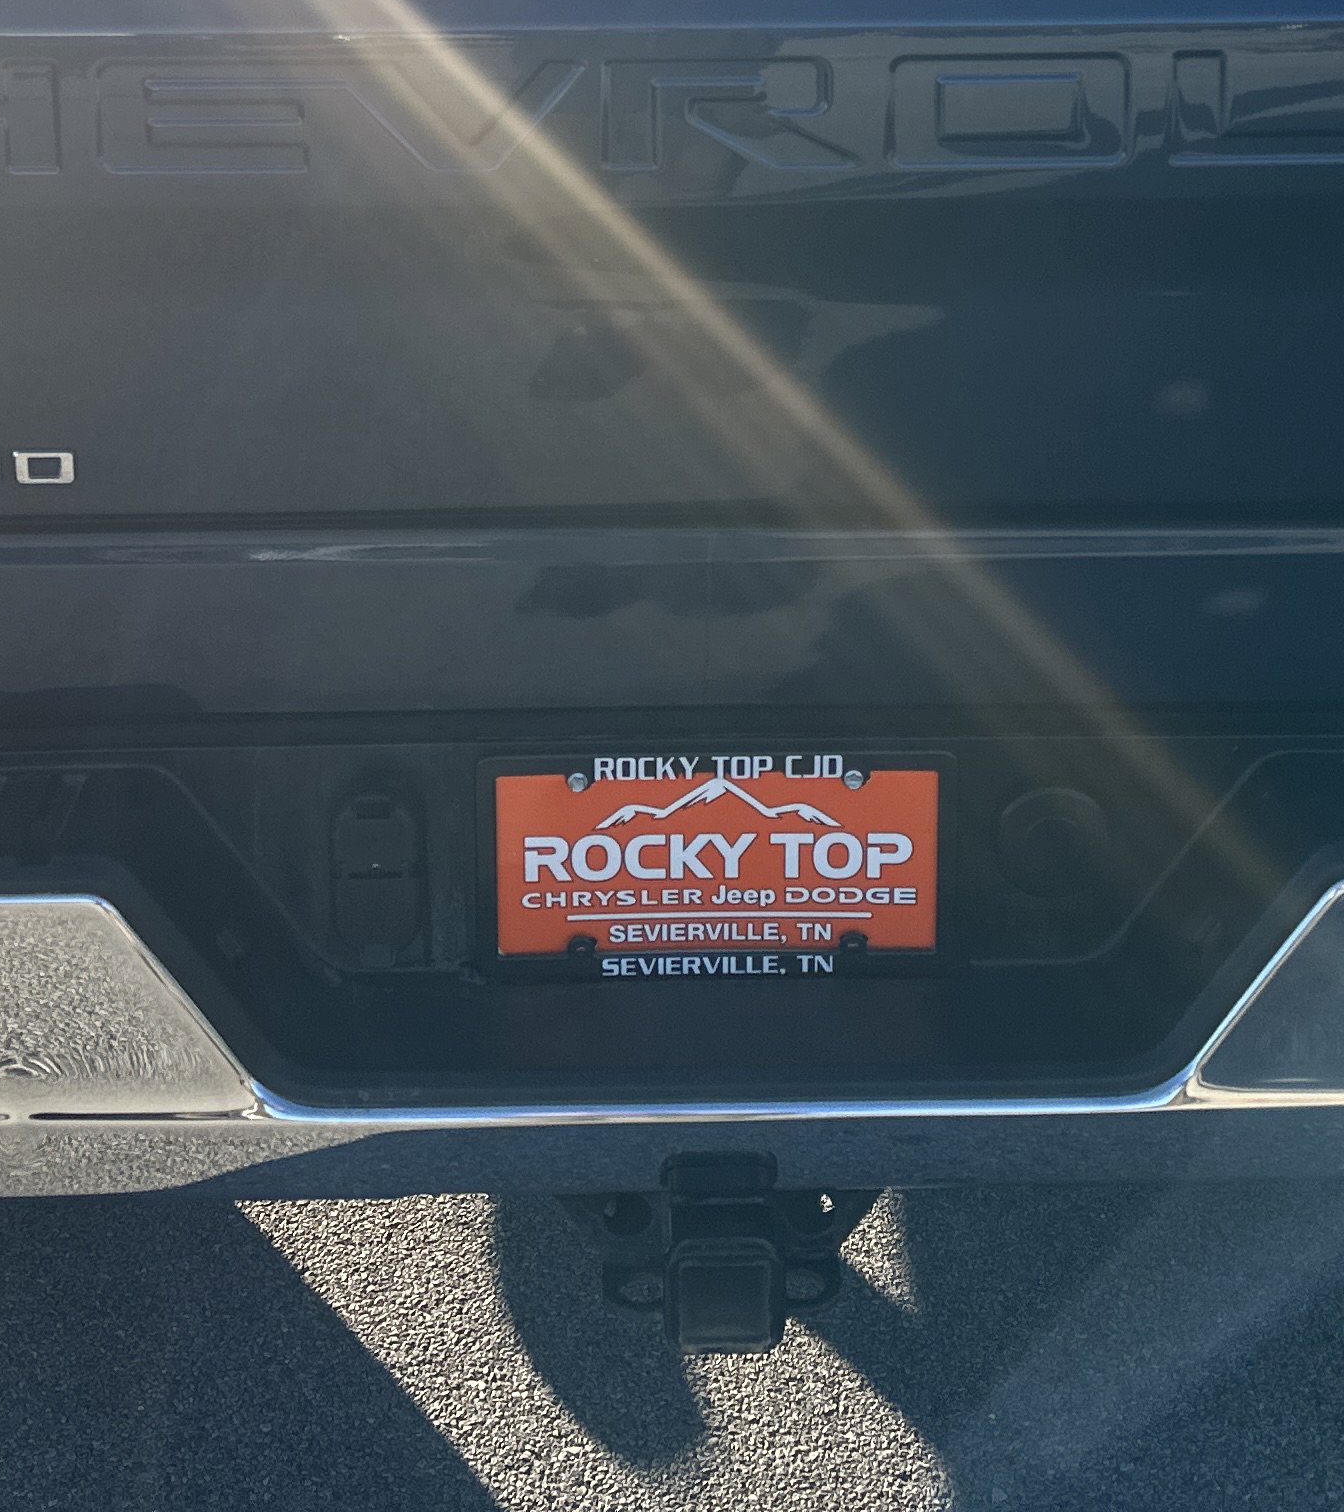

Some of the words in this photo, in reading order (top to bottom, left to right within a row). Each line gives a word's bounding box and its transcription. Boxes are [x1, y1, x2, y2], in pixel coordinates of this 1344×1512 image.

[593, 756, 700, 781] ROCKY
[711, 755, 774, 780] TOP
[785, 754, 844, 779] CJD
[523, 833, 758, 883] ROCKY
[769, 831, 914, 880] TOP
[521, 888, 703, 909] CHRYSLER
[711, 885, 777, 908] Jeep
[785, 886, 918, 906] DODGE
[608, 923, 788, 945] SEVIERVILLE,
[796, 922, 832, 941] TN
[601, 955, 787, 977] SEVIERVILLE,
[798, 954, 834, 974] TN
